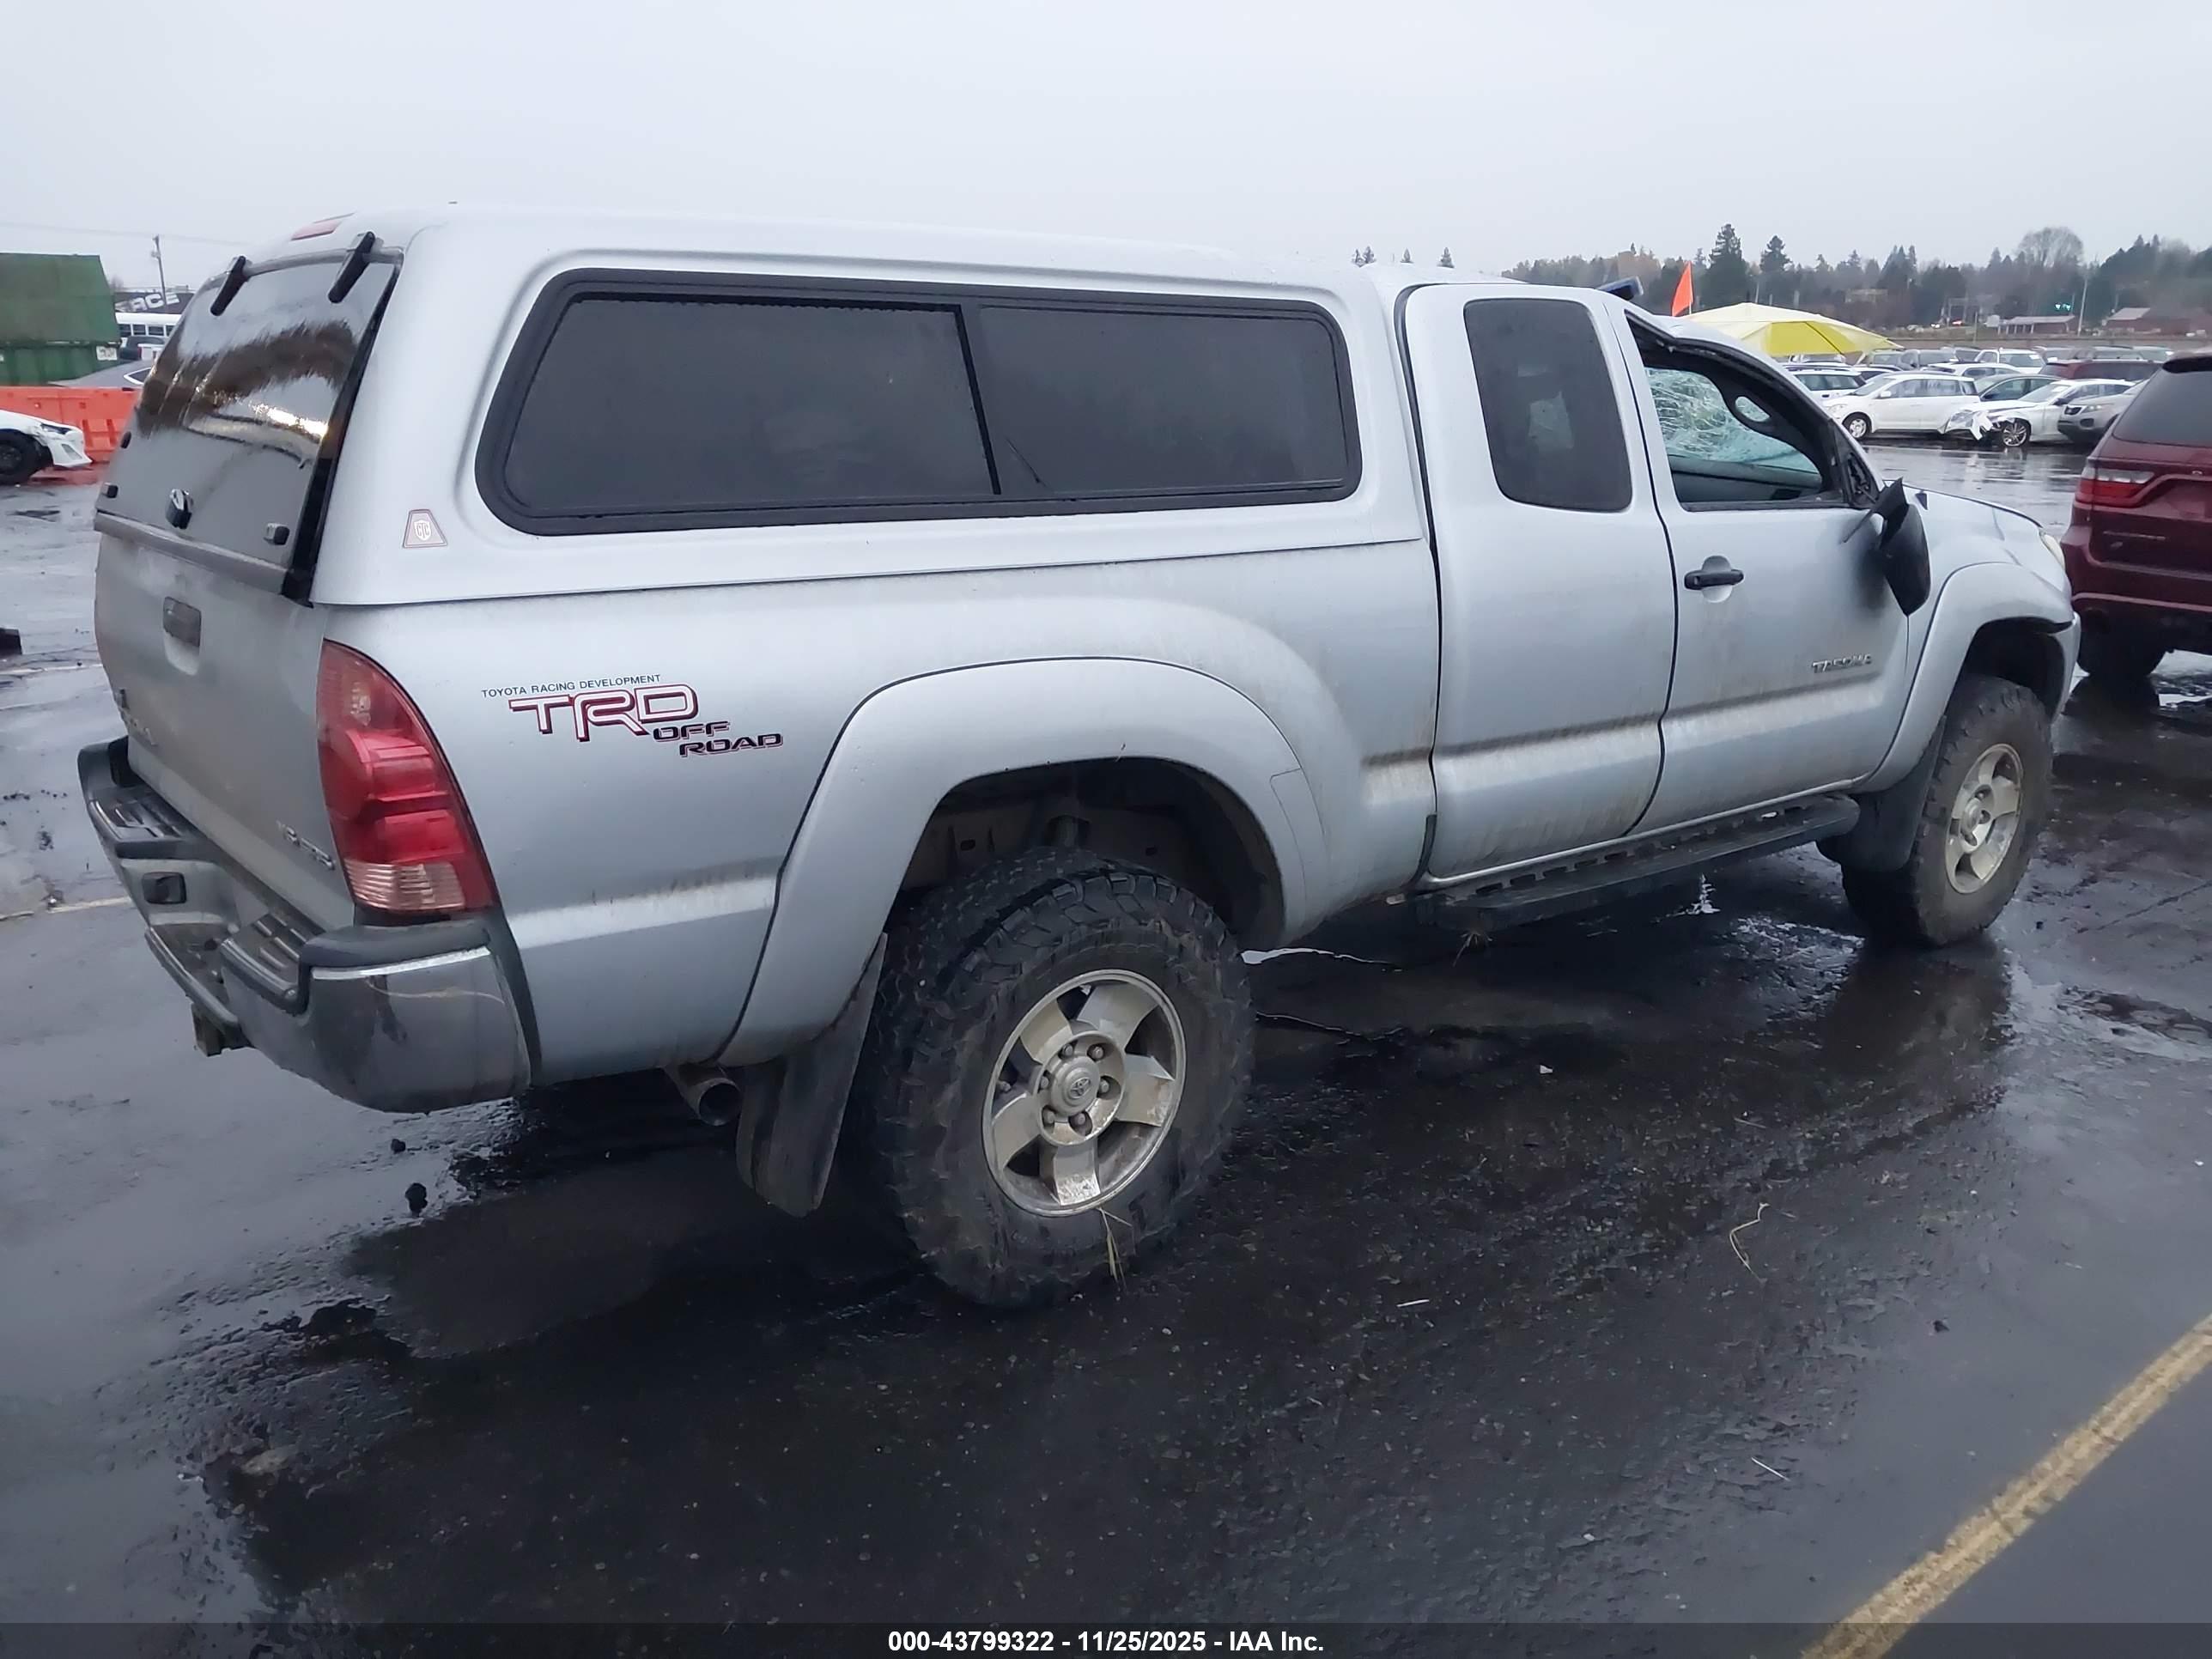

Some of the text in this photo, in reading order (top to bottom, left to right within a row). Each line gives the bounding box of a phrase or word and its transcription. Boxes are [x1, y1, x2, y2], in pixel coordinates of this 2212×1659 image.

[482, 674, 660, 698] TOYOTA RACING DEVELOPMENT
[508, 684, 698, 742] TRD
[653, 721, 731, 742] OFF
[679, 733, 783, 757] ROAD
